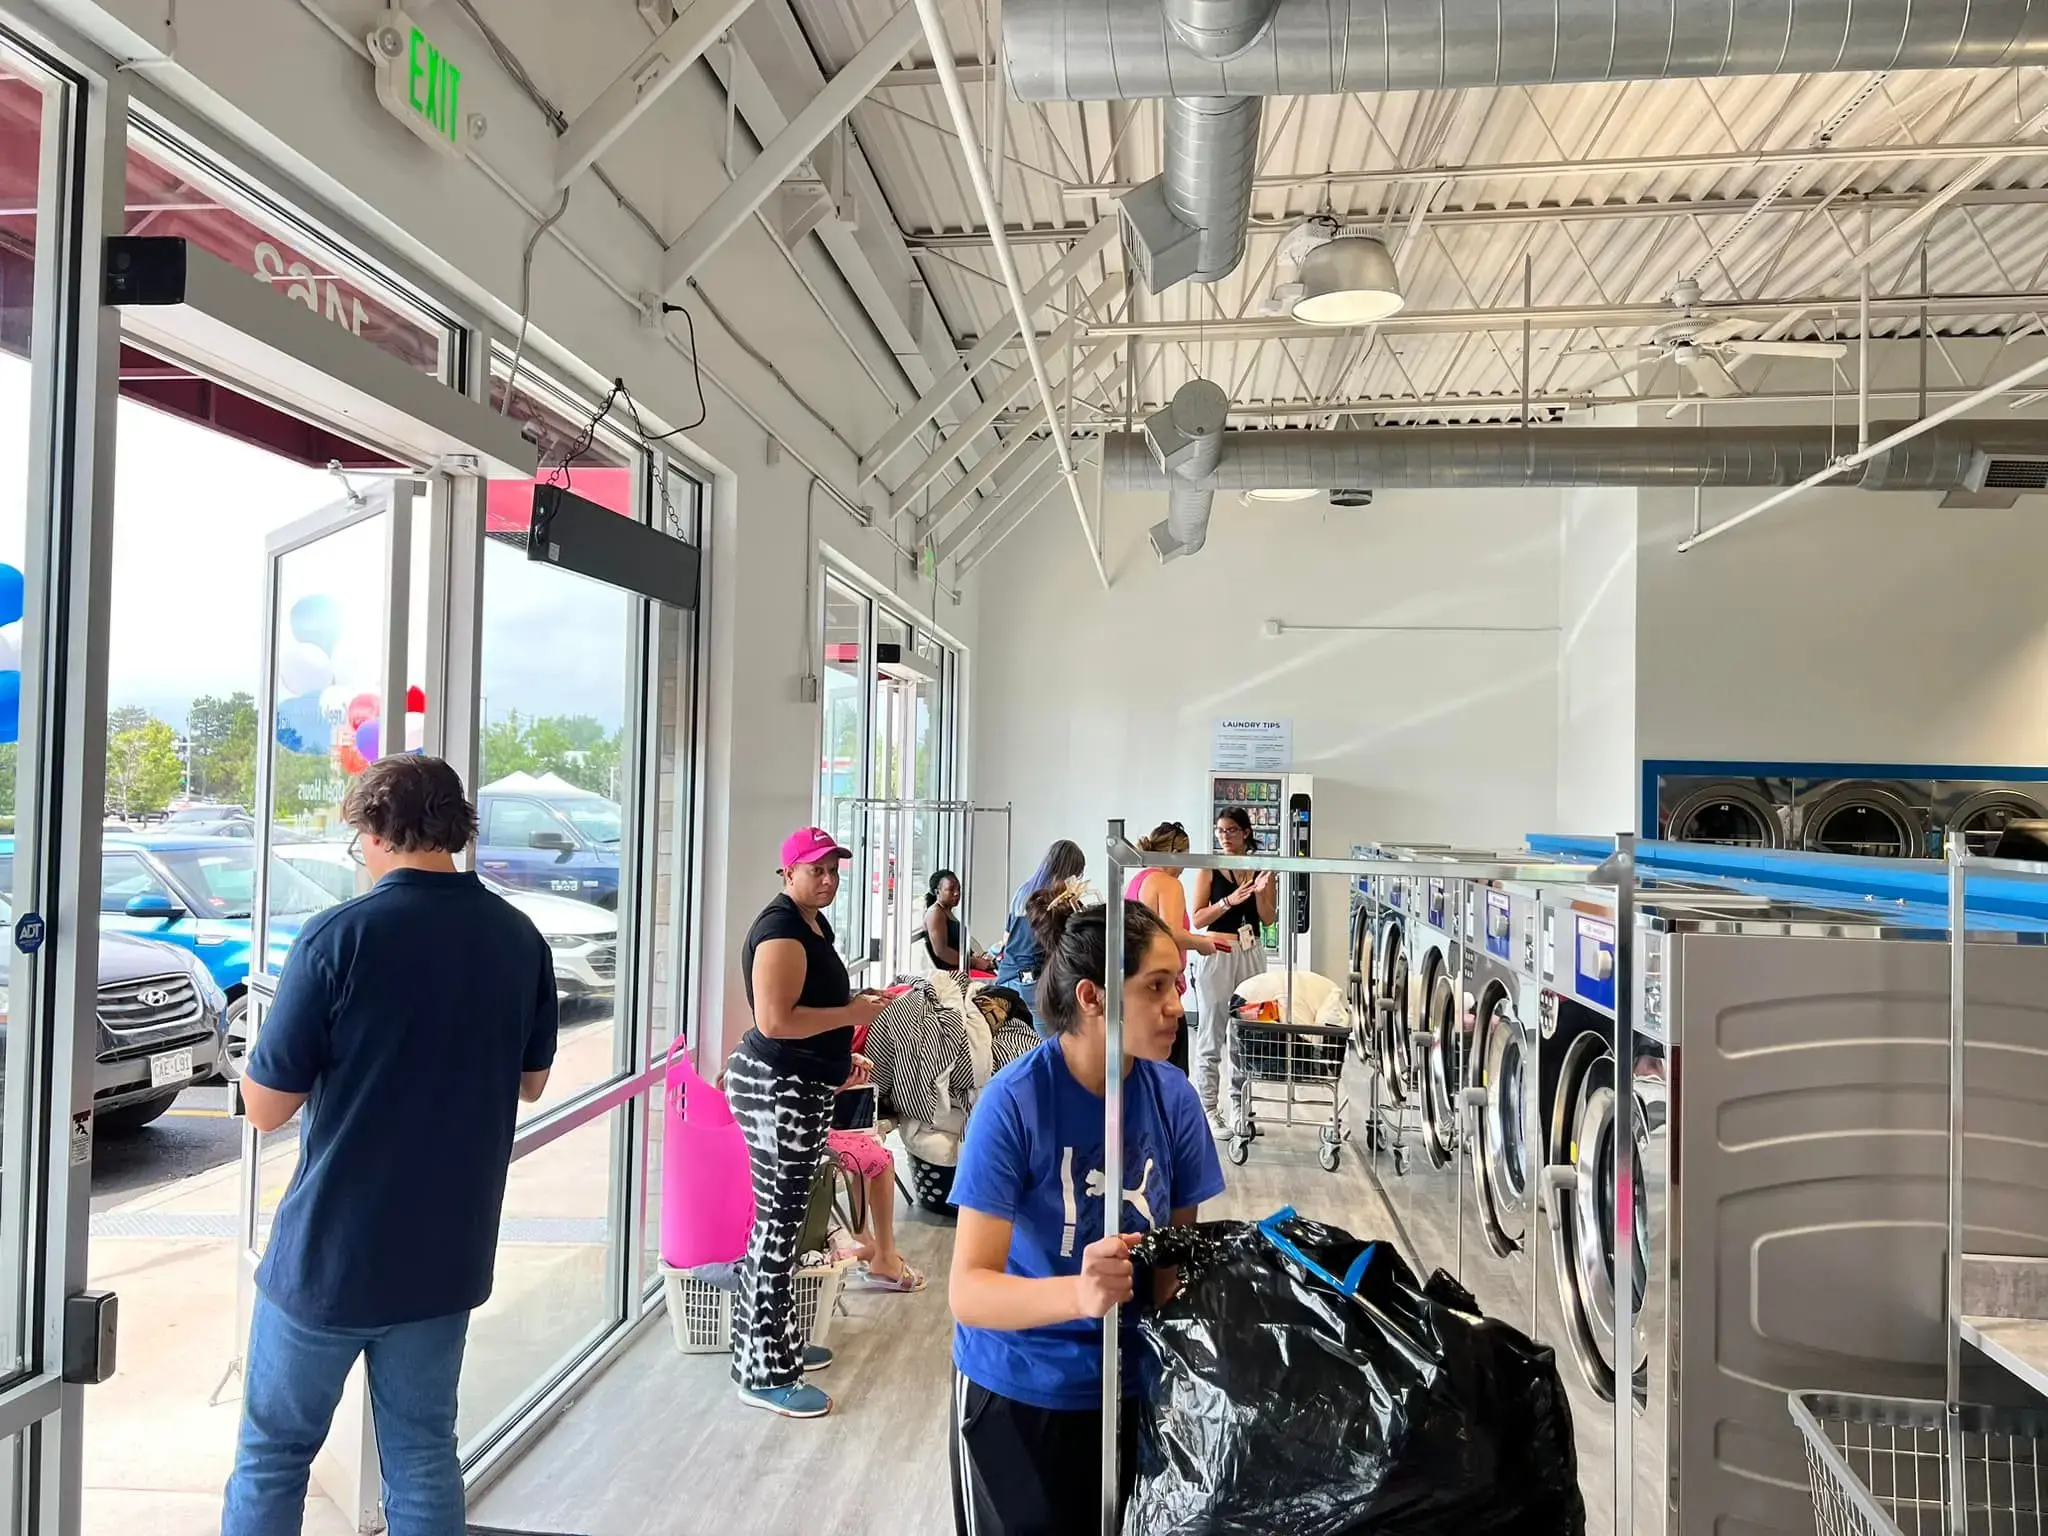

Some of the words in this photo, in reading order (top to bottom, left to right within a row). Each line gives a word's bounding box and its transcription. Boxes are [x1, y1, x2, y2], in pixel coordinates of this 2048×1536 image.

[408, 25, 461, 142] EXIT
[1221, 720, 1261, 728] LAUNDRY
[1262, 721, 1281, 729] TIPS
[19, 923, 42, 939] ADT
